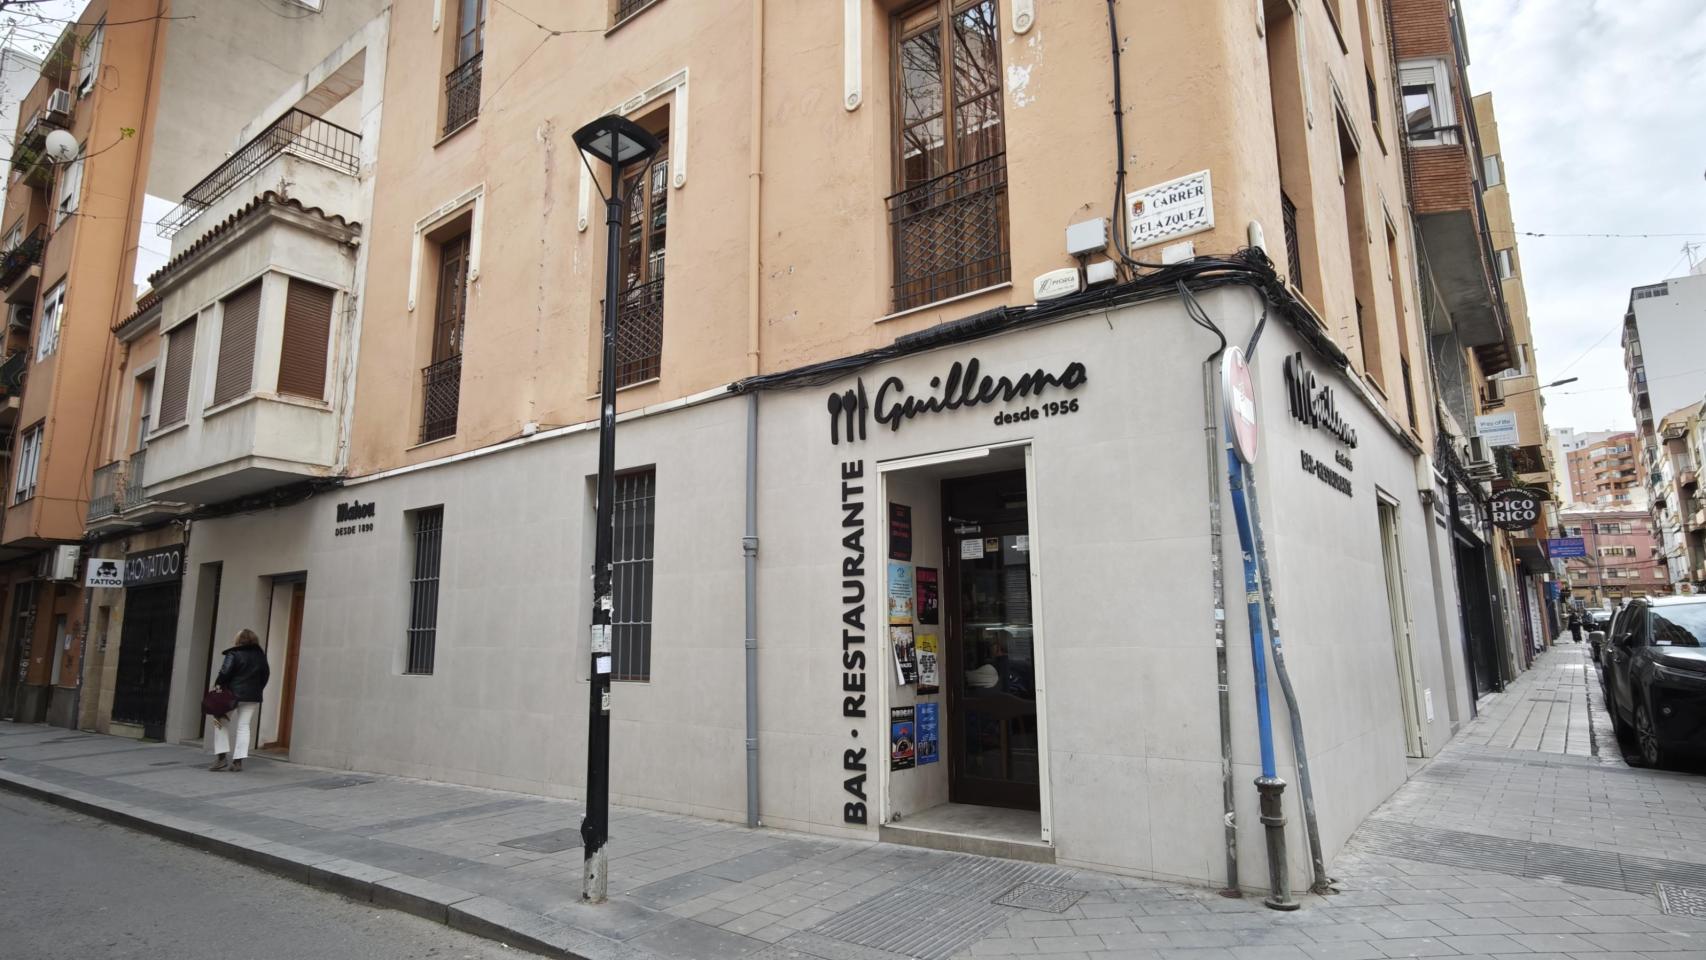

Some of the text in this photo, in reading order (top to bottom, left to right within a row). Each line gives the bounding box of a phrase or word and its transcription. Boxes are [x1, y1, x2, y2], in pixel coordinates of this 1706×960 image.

[1152, 185, 1204, 209] CARRER
[1131, 206, 1206, 236] VELAZQUEZ
[874, 357, 1088, 432] Guillermo
[993, 398, 1079, 426] desde 1956
[336, 499, 376, 523] Mahou
[1491, 499, 1534, 511] PICO
[1492, 510, 1536, 522] RICO
[335, 523, 374, 537] DESDE 1890
[147, 550, 180, 577] TATTOO
[90, 578, 122, 586] TATTOO
[841, 459, 868, 826] BAR RESTAURANTE
